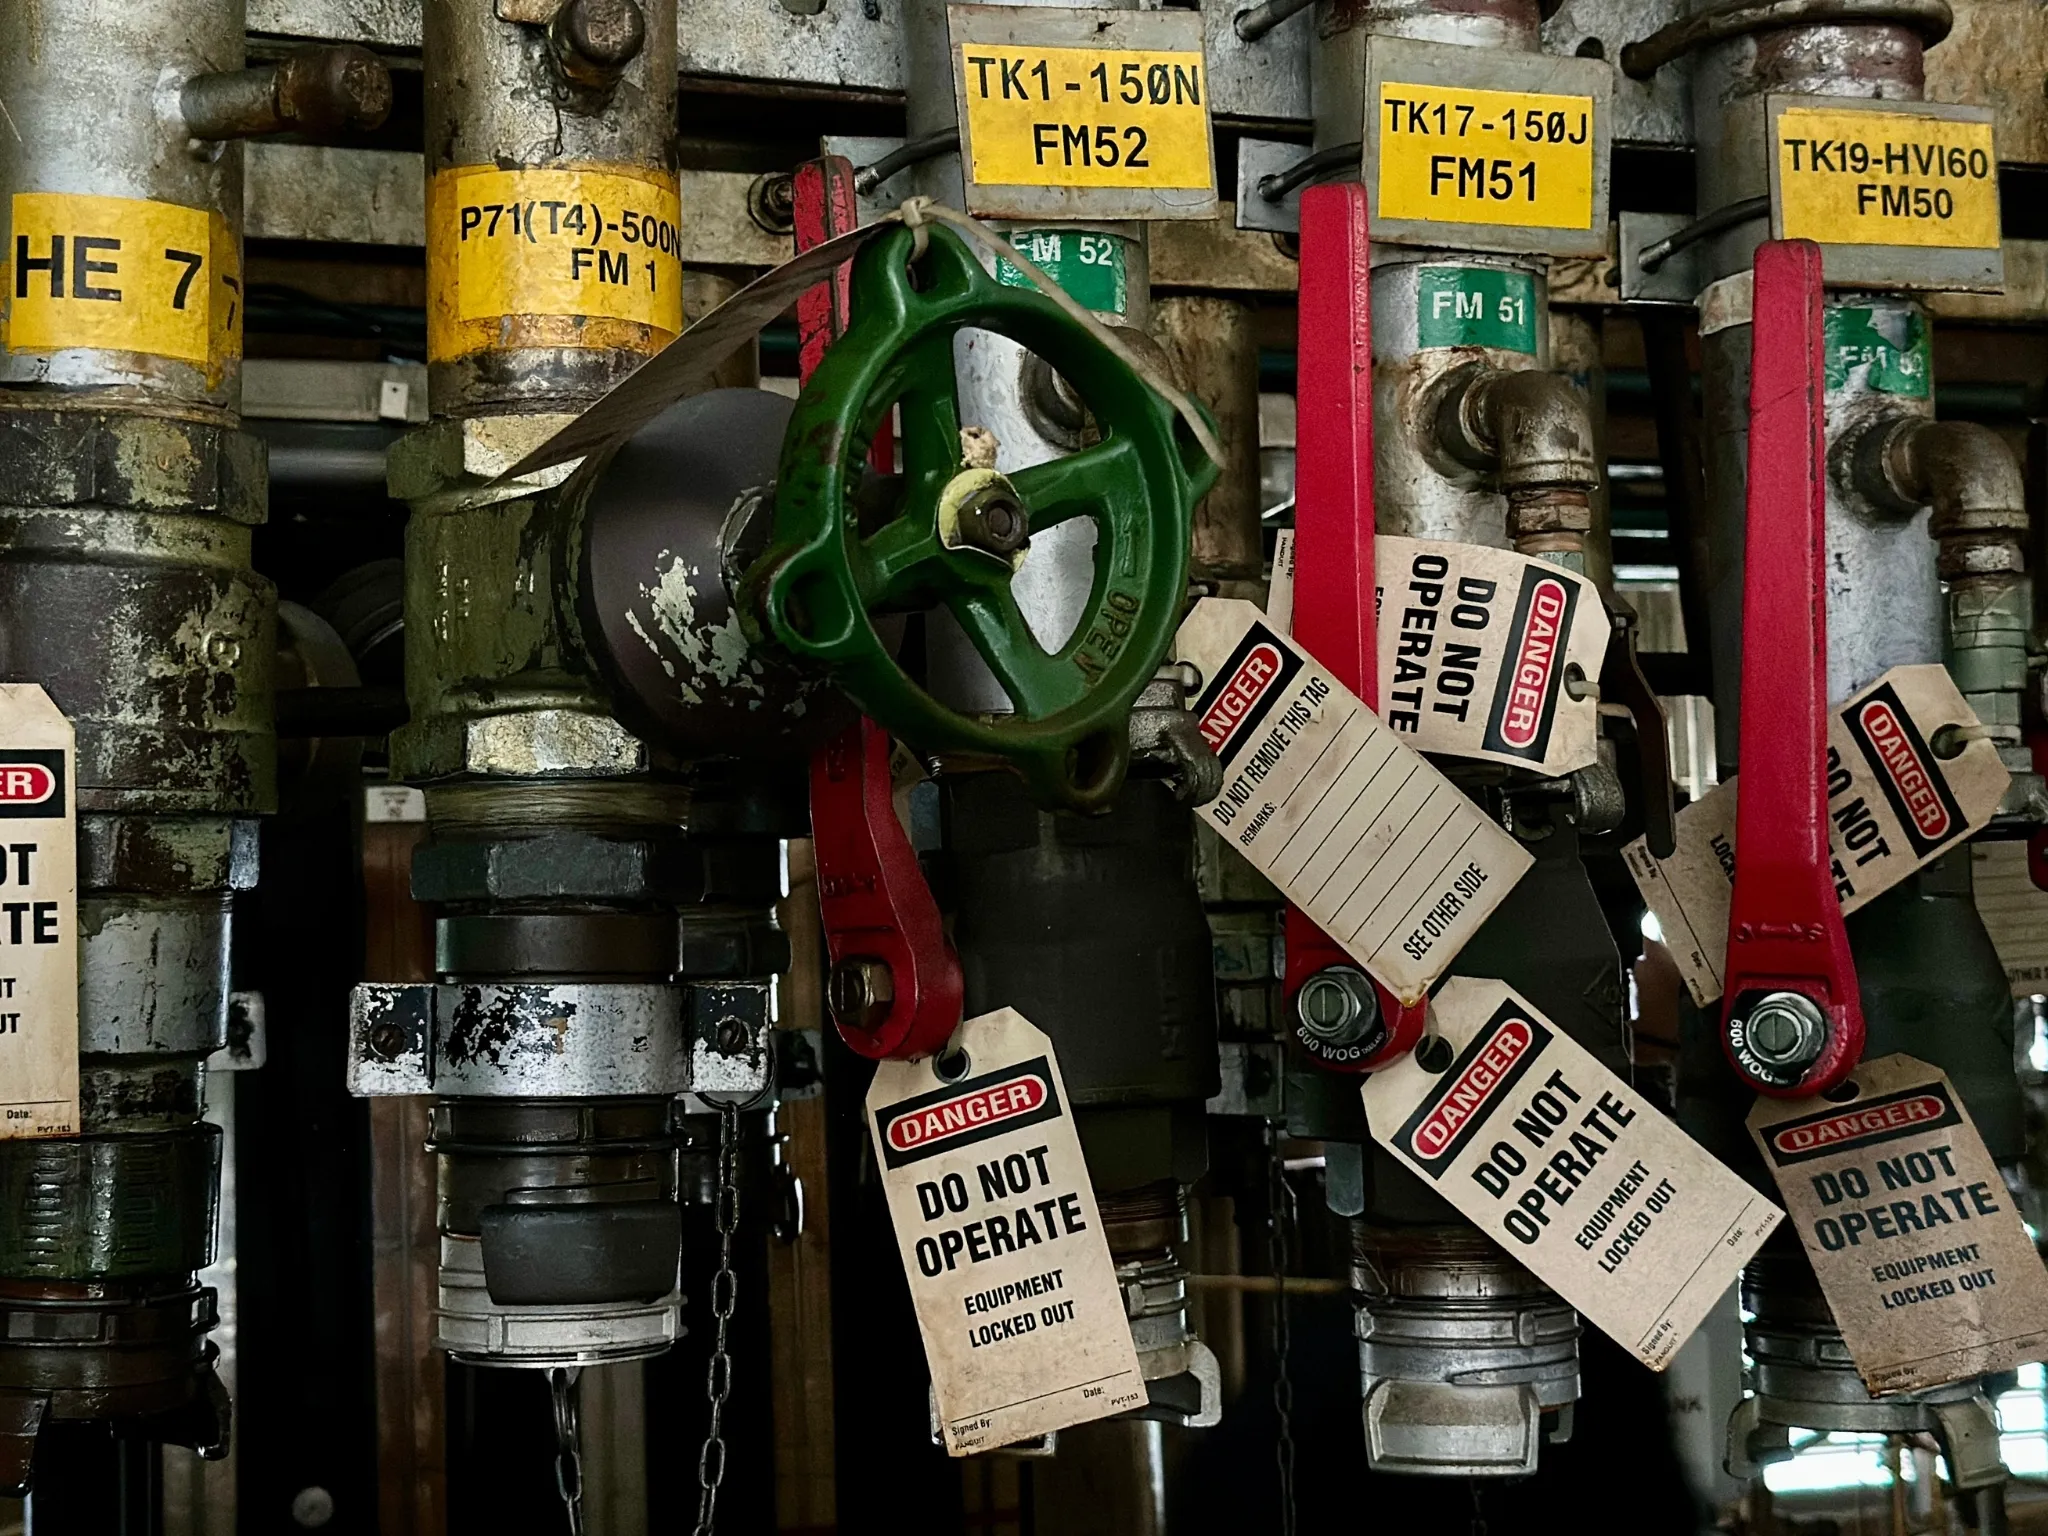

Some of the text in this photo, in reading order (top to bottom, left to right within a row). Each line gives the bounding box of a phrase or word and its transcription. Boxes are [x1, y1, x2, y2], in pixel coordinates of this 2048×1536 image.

[1033, 123, 1149, 167] FM52
[1430, 155, 1535, 201] FM51
[1857, 184, 1953, 219] FM50
[16, 235, 203, 310] HE 7
[571, 247, 656, 292] FM 1
[1079, 236, 1113, 266] 52
[1432, 291, 1524, 326] FM 51
[1388, 554, 1449, 734] OPERATE
[1432, 577, 1498, 722] DO NOT
[1507, 594, 1553, 737] DANGER
[1200, 658, 1271, 743] ANGER
[1212, 676, 1331, 828] DO NOT REMOVE THIS TAG
[1869, 713, 1941, 827] DANGER
[1239, 801, 1278, 846] REMARKS:
[1832, 797, 1891, 867] NOT
[1402, 861, 1489, 962] SEE OTHER SIDE
[1297, 1027, 1319, 1051] 600
[1322, 1045, 1360, 1061] WOG
[1730, 1019, 1773, 1082] 600 WOG
[901, 1085, 1033, 1144] DANGER
[1422, 1034, 1523, 1148] DANGER
[1471, 1068, 1583, 1200] DO NOT
[1791, 1099, 1927, 1148] DANGER
[916, 1145, 1050, 1222] DO NOT
[1503, 1091, 1637, 1246] OPERATE
[1811, 1146, 1954, 1206] DO NOT
[915, 1193, 1087, 1278] OPERATE
[1574, 1160, 1651, 1251] EQUIPMENT
[1597, 1177, 1677, 1275] LOCKED OUT
[1815, 1182, 1999, 1252] OPERATE
[964, 1269, 1063, 1315] EQUIPMENT
[1875, 1244, 1980, 1282] EQUIPMENT
[1881, 1269, 1998, 1310] LOCKED OUT
[969, 1301, 1075, 1348] LOCKED OUT
[1083, 1386, 1104, 1399] Date:
[952, 1420, 978, 1437] Signed
